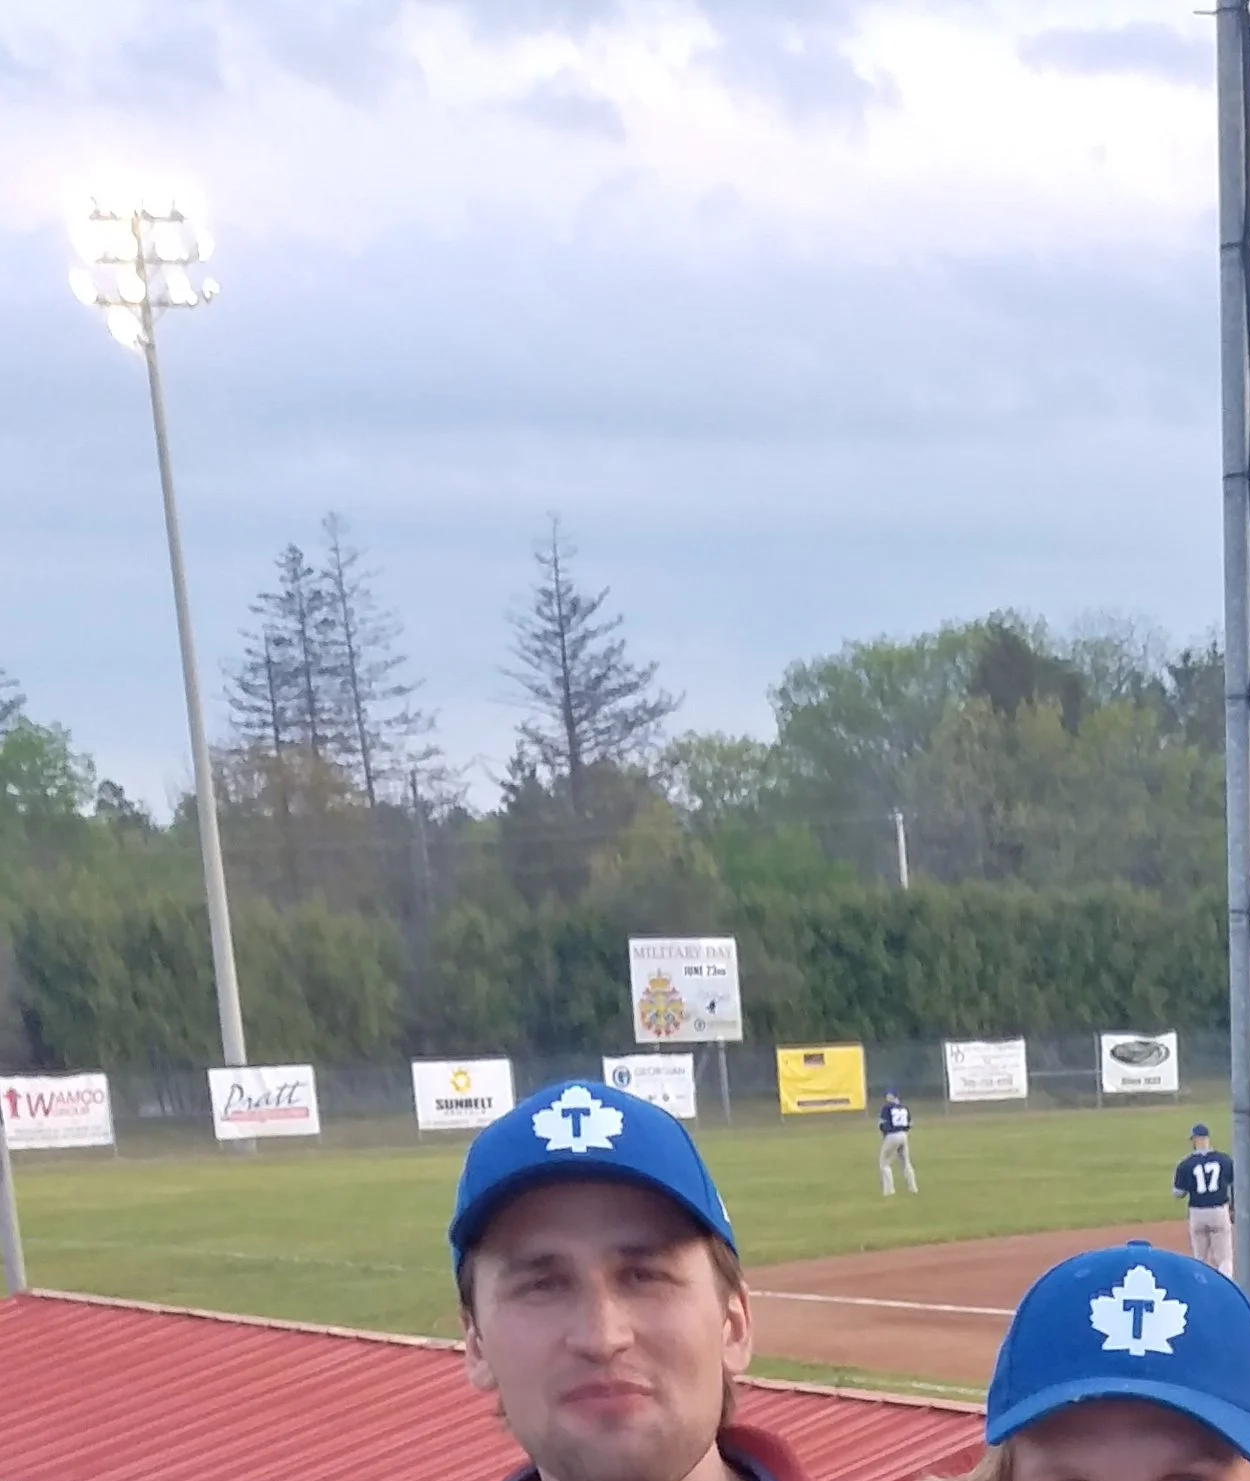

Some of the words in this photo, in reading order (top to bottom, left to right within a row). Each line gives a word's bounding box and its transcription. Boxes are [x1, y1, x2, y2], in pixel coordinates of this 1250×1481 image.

[706, 945, 735, 959] DAY
[435, 1097, 494, 1111] SUNBELT
[561, 1107, 591, 1138] T
[1193, 1160, 1222, 1194] 17
[1122, 1299, 1155, 1340] T
